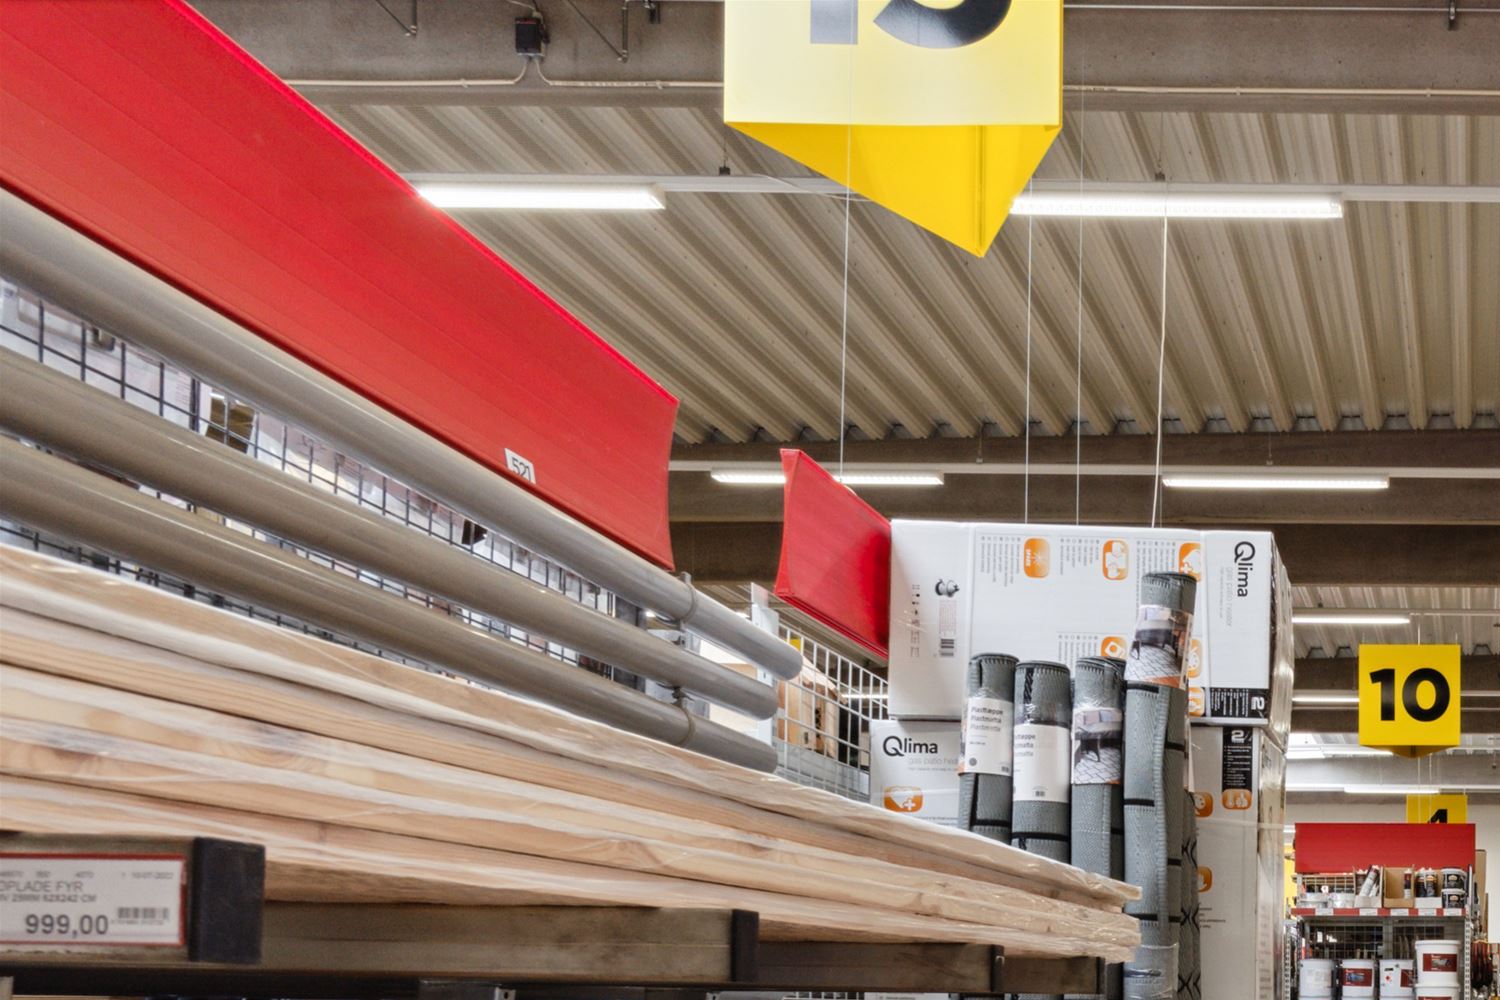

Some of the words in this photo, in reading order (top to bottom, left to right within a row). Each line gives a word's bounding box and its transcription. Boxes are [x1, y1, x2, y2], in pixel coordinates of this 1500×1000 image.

[512, 457, 532, 482] 521
[1234, 541, 1256, 597] Qlima
[1251, 696, 1265, 710] 2
[1369, 667, 1450, 722] 10
[883, 735, 939, 757] Qlima
[1231, 729, 1245, 743] 2
[56, 881, 83, 892] FYR
[25, 914, 109, 938] 999,00
